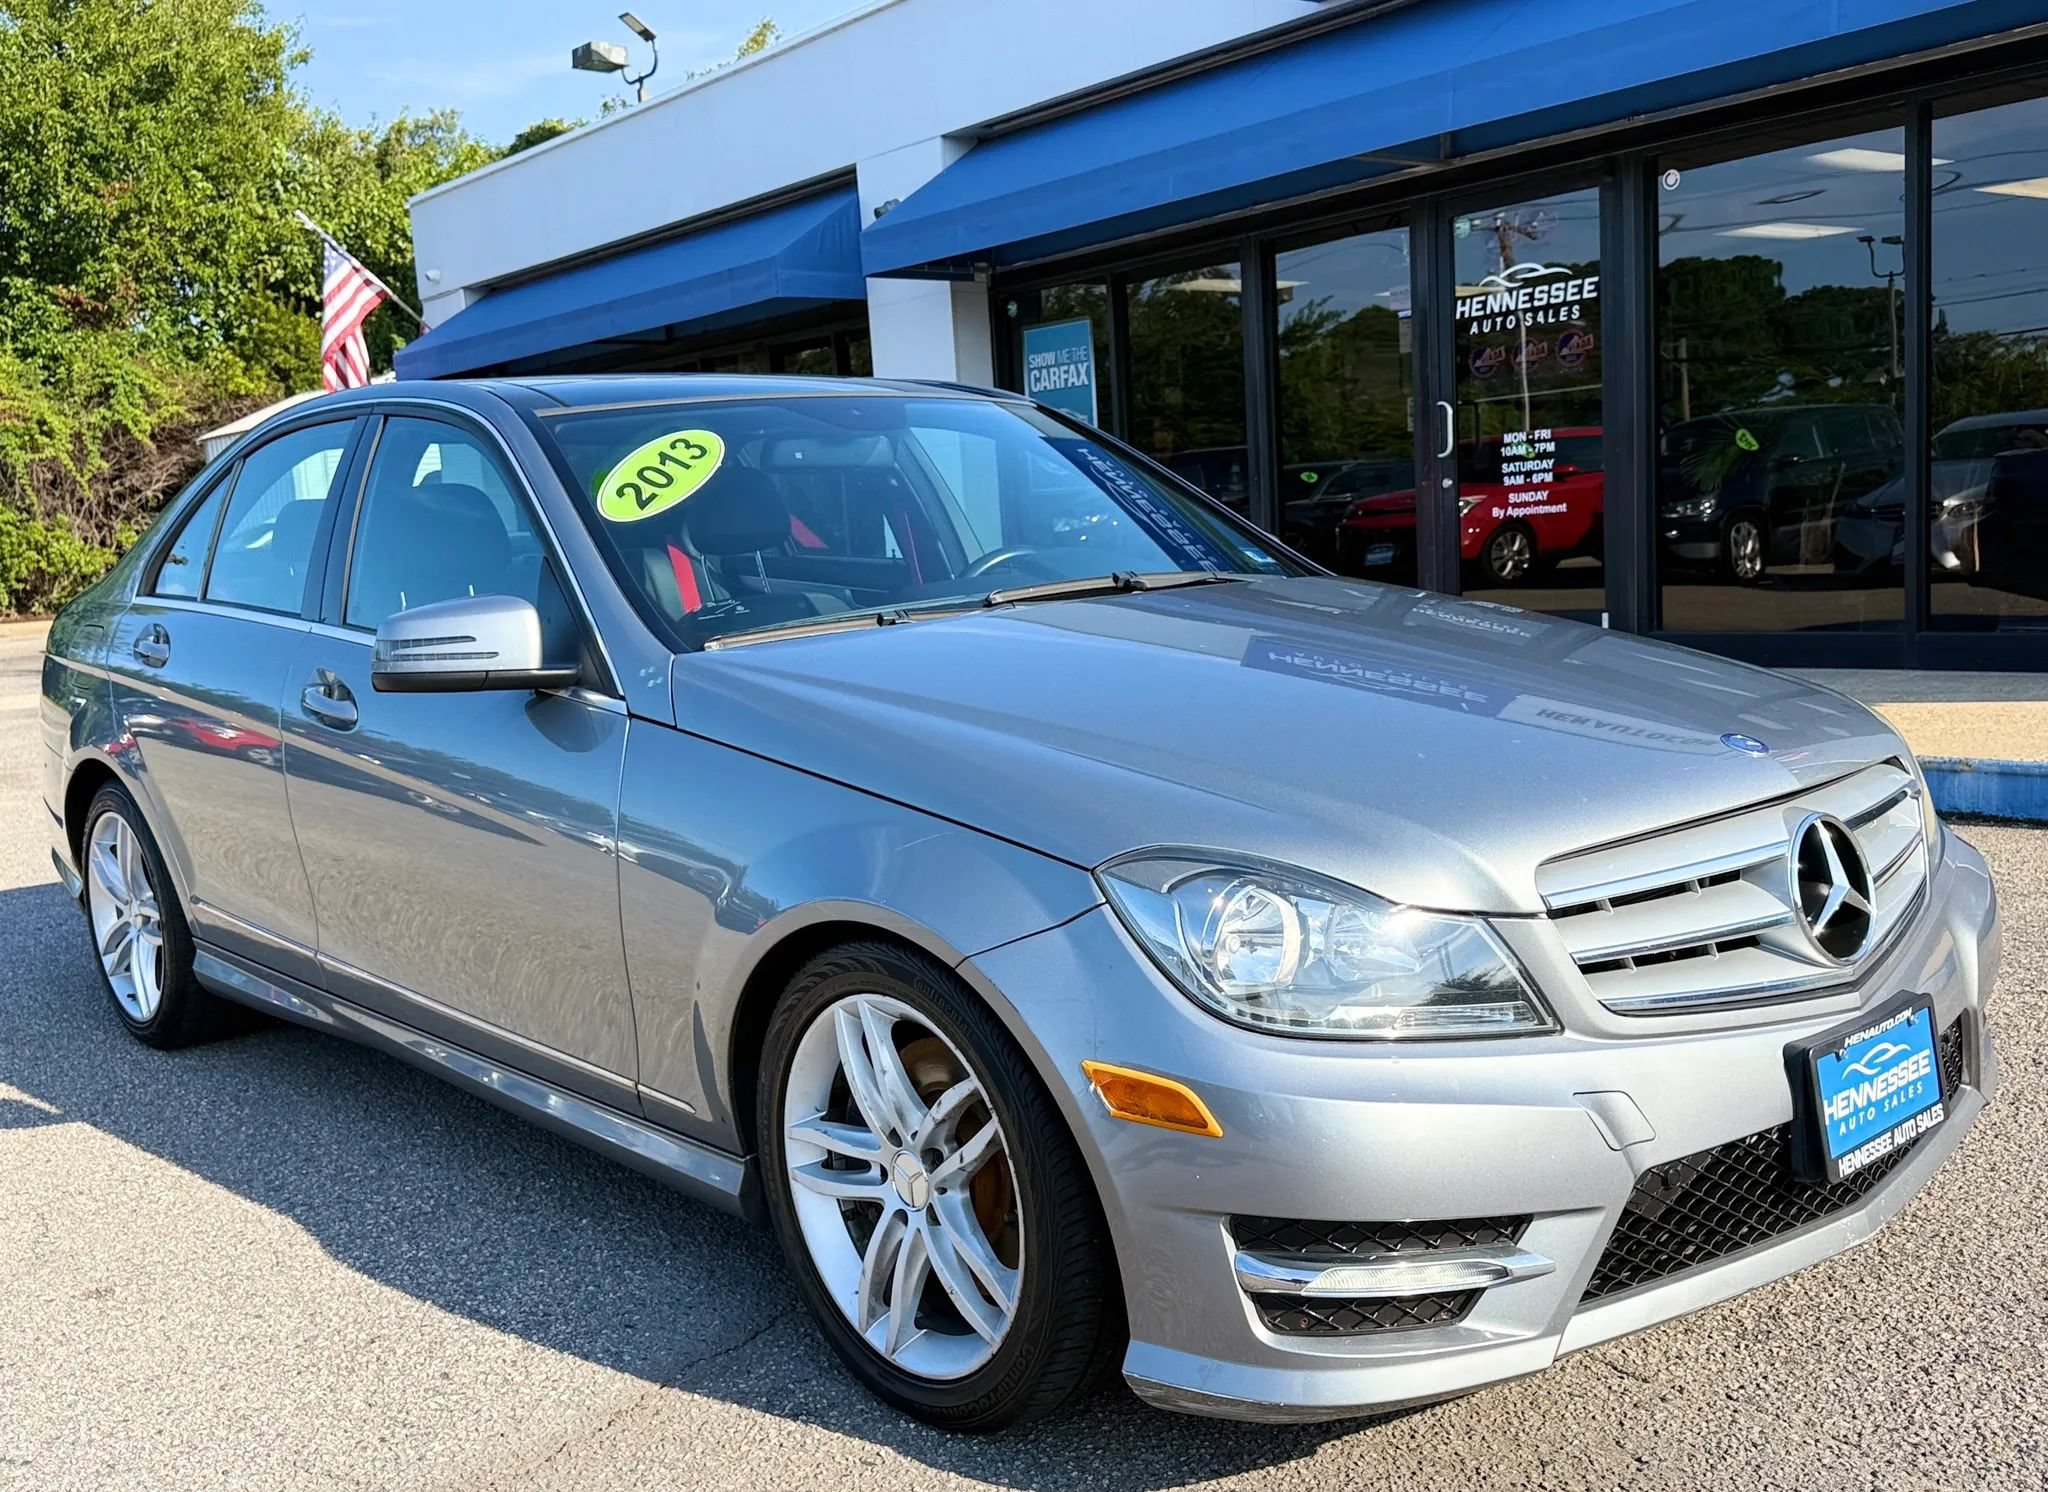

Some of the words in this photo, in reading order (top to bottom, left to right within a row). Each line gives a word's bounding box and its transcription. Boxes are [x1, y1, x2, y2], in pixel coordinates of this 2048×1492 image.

[1455, 275, 1600, 320] HENNESSEE
[1469, 316, 1517, 336] AUTO
[1524, 305, 1581, 326] SALES
[1028, 351, 1056, 369] SHOW
[1057, 348, 1070, 364] ME
[1070, 345, 1088, 361] THE
[1030, 362, 1089, 393] CARFAX
[1500, 445, 1527, 457] 10AM
[1534, 442, 1555, 453] 7PM
[1503, 432, 1527, 443] MON
[1534, 428, 1552, 440] FRI
[616, 438, 707, 510] 2013
[1501, 458, 1554, 473] SATURDAY
[1503, 475, 1525, 486] 9AM
[1532, 472, 1553, 484] 6PM
[1492, 507, 1505, 519] By
[1506, 503, 1567, 518] Appointment
[1508, 490, 1549, 503] SUNDAY
[1844, 1006, 1914, 1047] HENAUTO.COM
[1823, 1048, 1931, 1125] HENNESSEE
[1839, 1108, 1876, 1136] AUTO
[1884, 1081, 1923, 1112] SALES
[1838, 1135, 1894, 1178] HENNESSEE
[1893, 1120, 1917, 1147] AUTO
[1917, 1102, 1944, 1135] SALES
